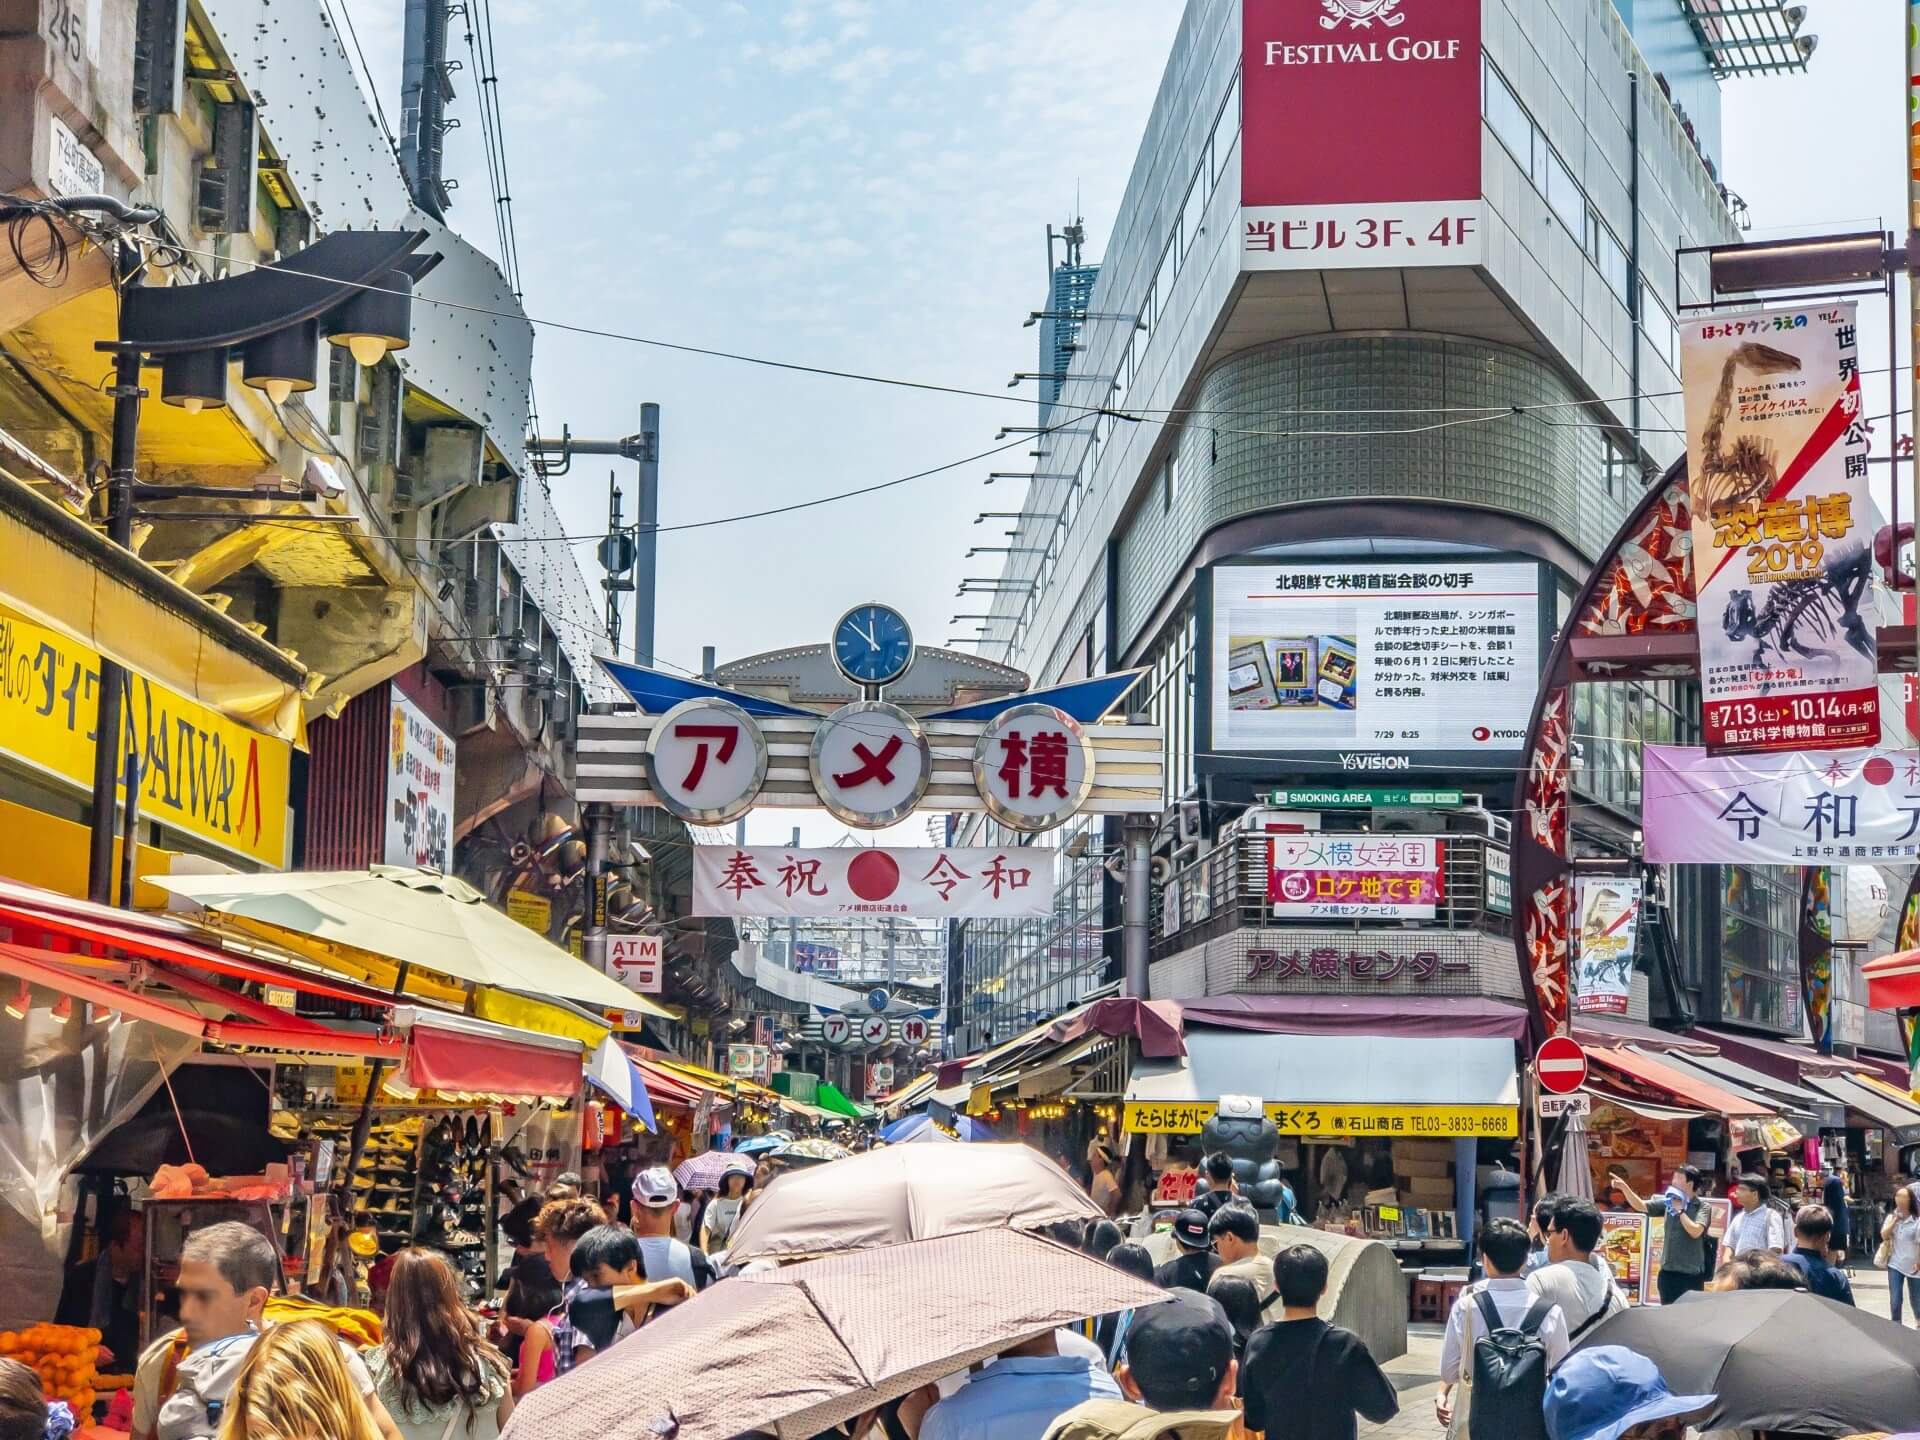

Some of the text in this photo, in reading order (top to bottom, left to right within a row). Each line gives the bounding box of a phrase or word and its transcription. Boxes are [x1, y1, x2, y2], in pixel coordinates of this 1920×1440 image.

[49, 0, 81, 62] 245
[1264, 36, 1459, 65] FESTIVAL GOLF
[1702, 315, 1808, 339] ほっとタウンうえの
[1740, 399, 1807, 414] デイノケイルス
[1836, 324, 1868, 479] 世界初公開
[1711, 492, 1854, 548] 恐竜博
[1746, 540, 1824, 574] 2019
[1276, 573, 1474, 590] 北朝鮮で米朝首脳会談の切手
[1375, 731, 1419, 739] 7/29 8:25
[1493, 730, 1527, 738] KYODO
[1724, 723, 1825, 743] 国立科学博物館
[675, 724, 1069, 799] アメ横
[1290, 793, 1372, 803] SMOKING AREA
[1286, 841, 1425, 867] アメ横女学園
[716, 850, 1033, 901] 奉祝 令和
[1316, 876, 1425, 898] ロケ地です
[1310, 906, 1399, 916] アメ横センタービル
[612, 941, 656, 957] ATM
[1247, 949, 1470, 982] アメ横センター
[829, 1020, 923, 1041] アメ横
[1542, 1099, 1587, 1112] 自転車除く
[1135, 1107, 1209, 1128] たらばがに
[1274, 1110, 1321, 1130] まぐろ
[1411, 1115, 1508, 1132] TEL03-3833-6668
